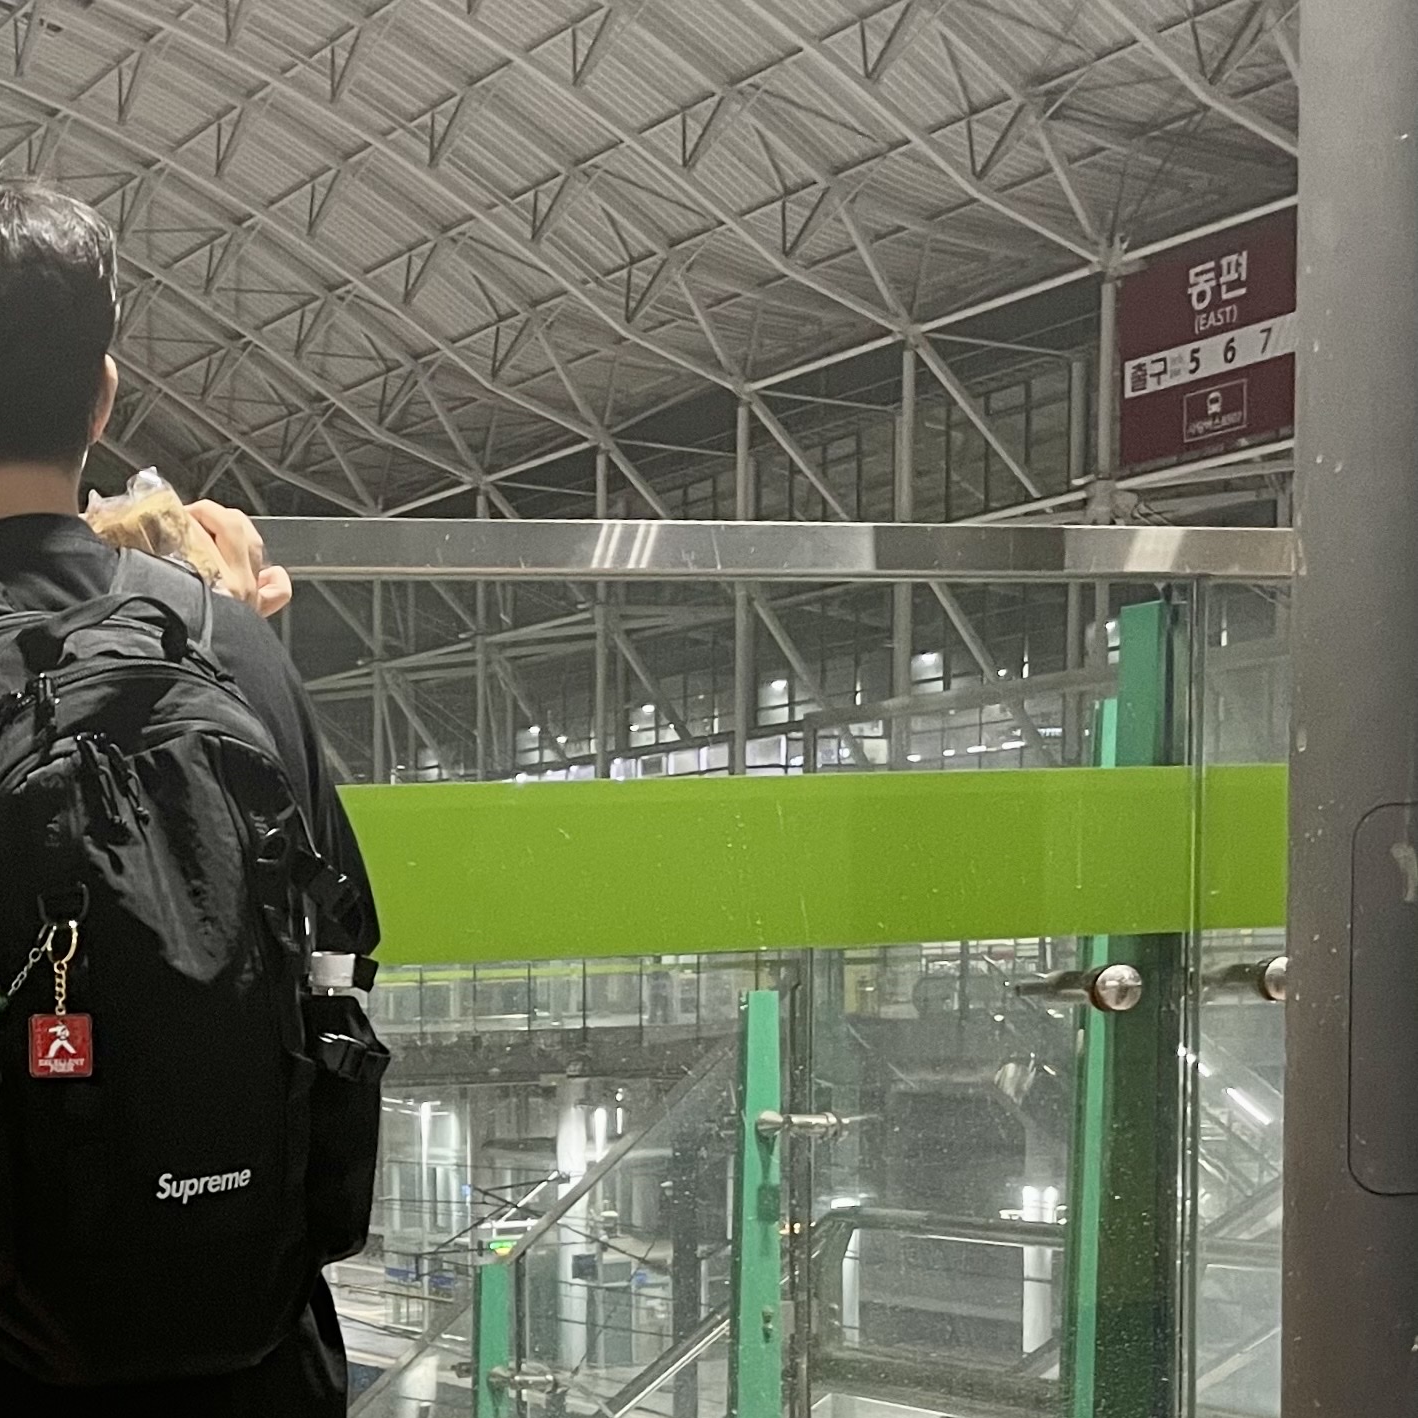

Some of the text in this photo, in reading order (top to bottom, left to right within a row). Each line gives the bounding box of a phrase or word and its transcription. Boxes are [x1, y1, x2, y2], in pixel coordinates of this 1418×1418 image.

[1187, 250, 1249, 311] 동편
[1194, 304, 1238, 335] (EAST)
[1188, 347, 1201, 375] 5
[1223, 336, 1237, 364] 6
[1259, 326, 1272, 355] 7
[155, 1168, 252, 1205] Supreme
